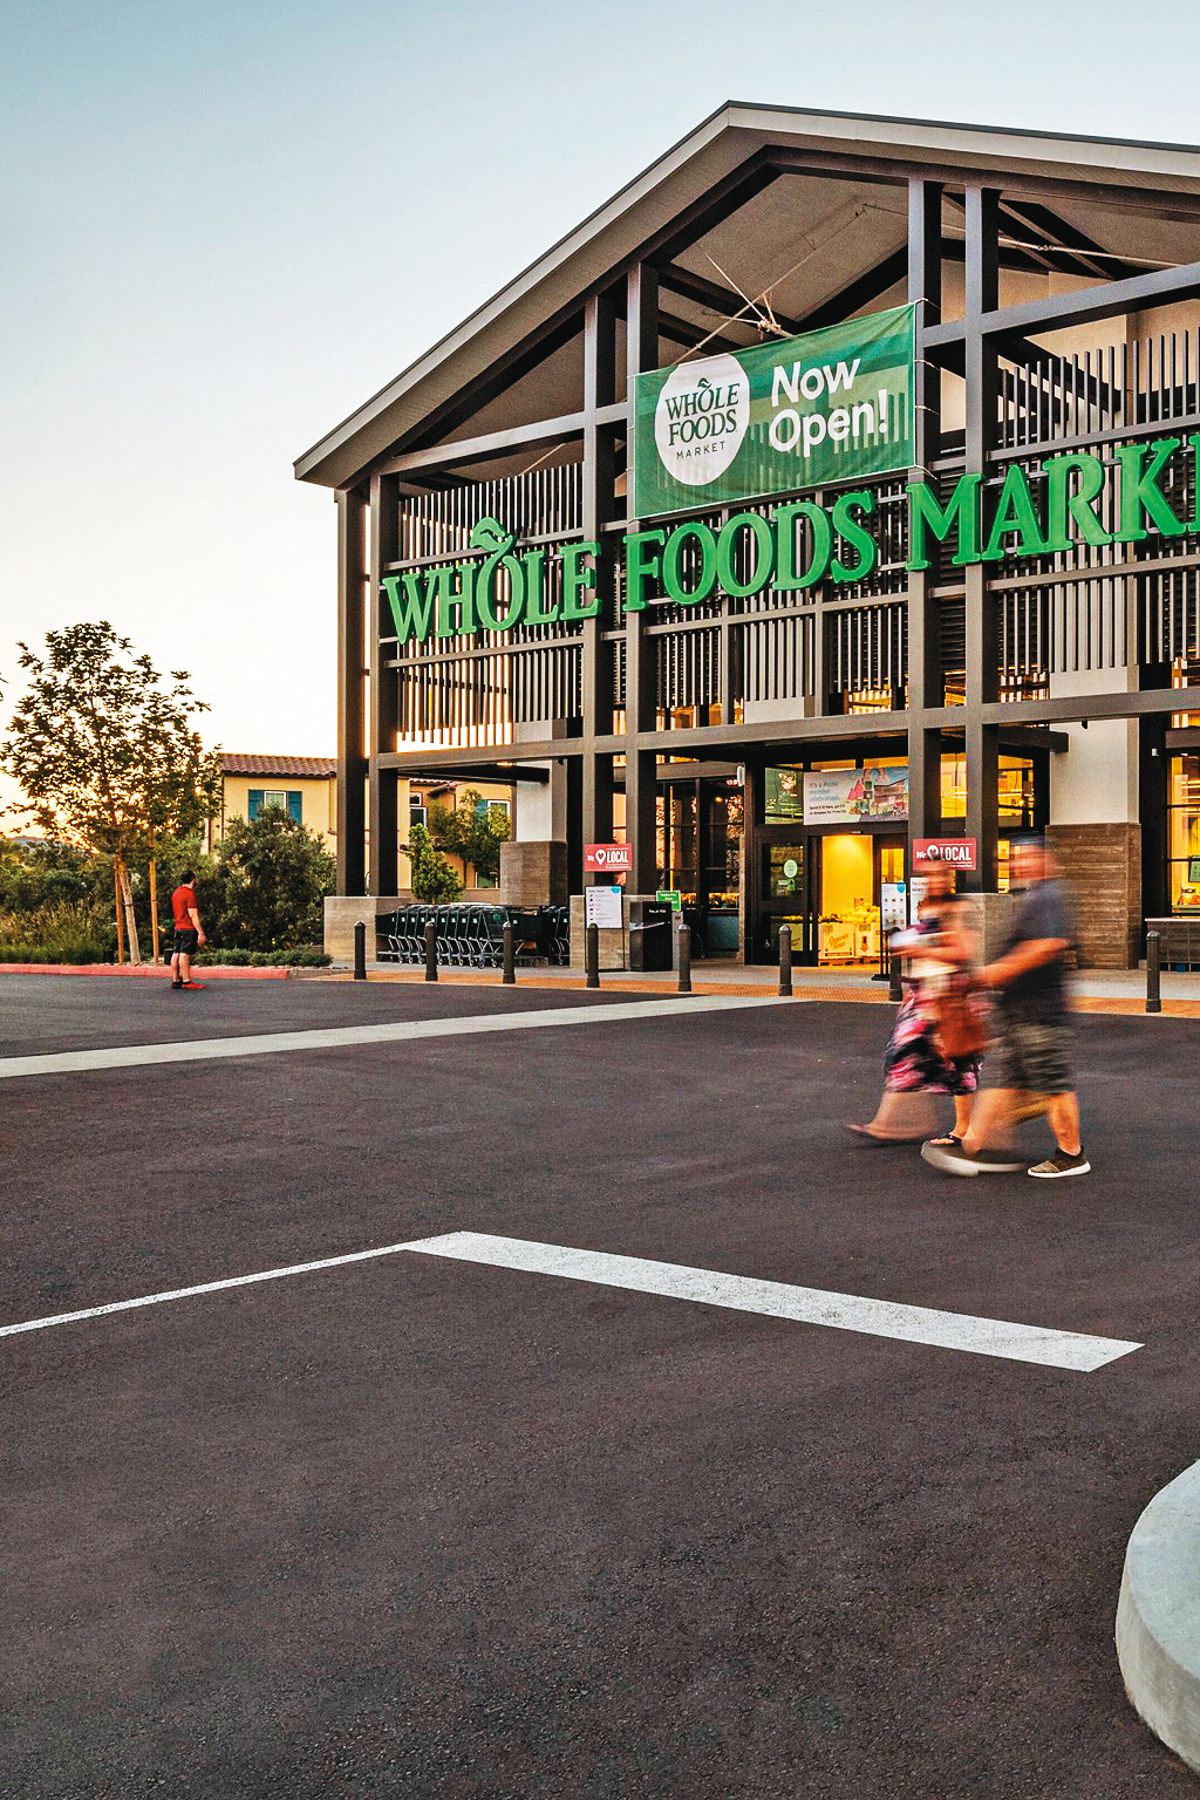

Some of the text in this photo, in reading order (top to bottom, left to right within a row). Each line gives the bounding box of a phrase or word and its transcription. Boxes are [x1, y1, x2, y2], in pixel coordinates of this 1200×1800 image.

[665, 378, 740, 421] WHOLE
[772, 358, 860, 407] Now
[668, 408, 737, 446] FOODS
[768, 389, 888, 458] Open!
[676, 441, 725, 460] MARKET
[382, 517, 601, 645] WHOLE
[622, 489, 879, 613] FOODS
[607, 850, 629, 863] LOCAL
[940, 846, 972, 861] LOCAL
